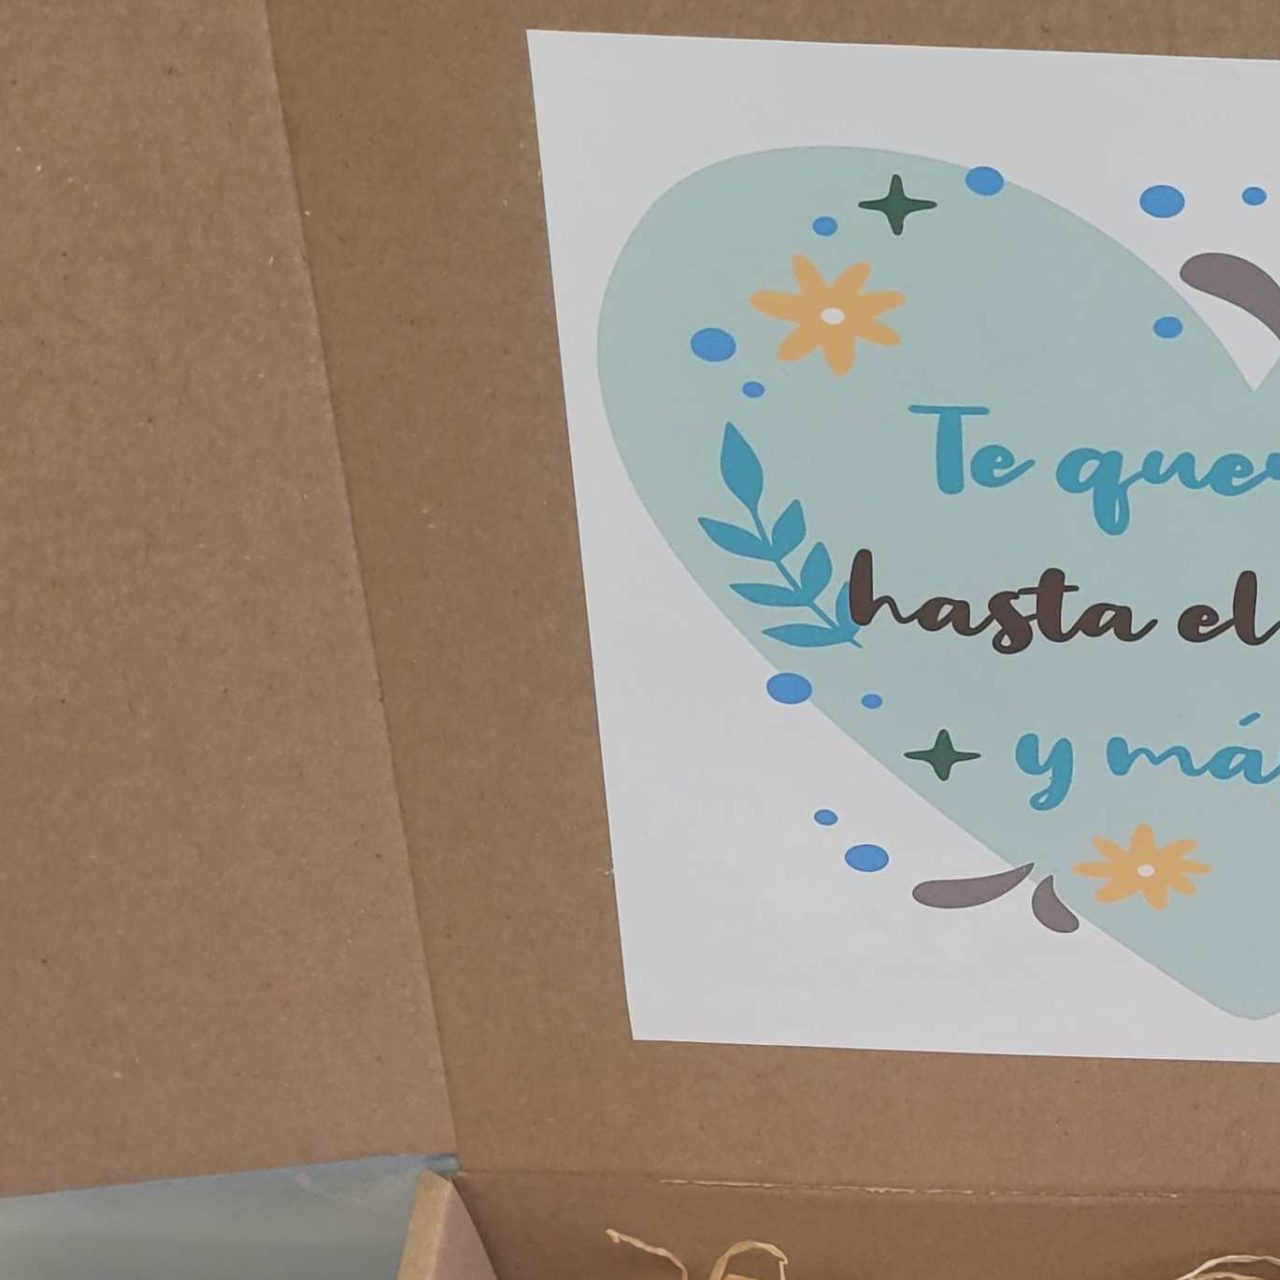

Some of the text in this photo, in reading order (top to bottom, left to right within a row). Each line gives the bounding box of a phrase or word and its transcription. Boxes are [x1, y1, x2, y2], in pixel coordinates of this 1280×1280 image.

[908, 404, 1036, 496] Te
[848, 548, 1158, 655] hasta
[1015, 732, 1074, 812] y
